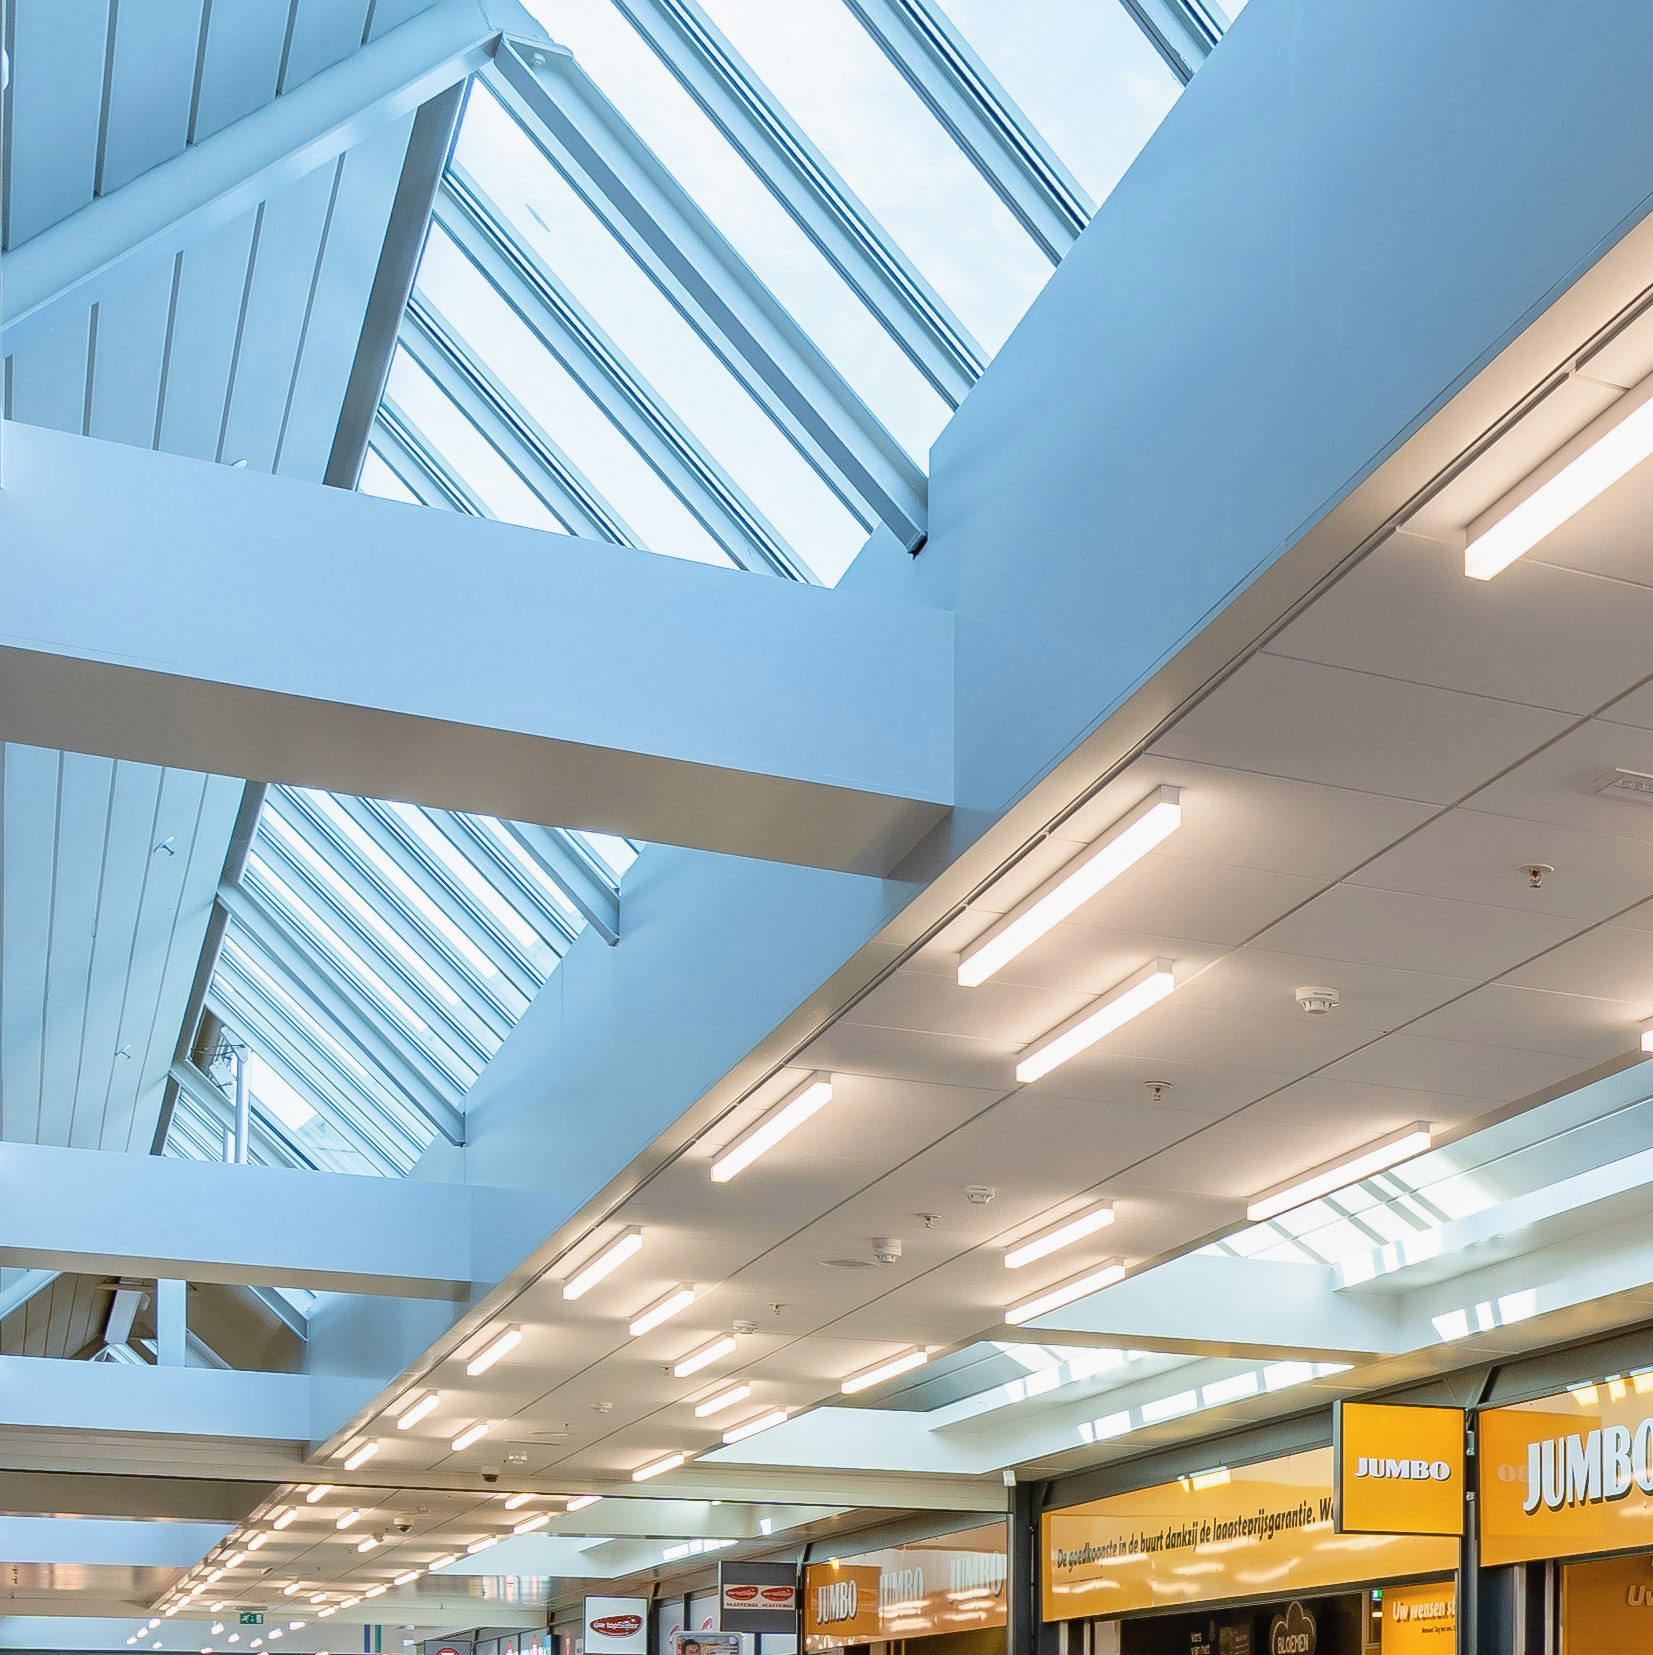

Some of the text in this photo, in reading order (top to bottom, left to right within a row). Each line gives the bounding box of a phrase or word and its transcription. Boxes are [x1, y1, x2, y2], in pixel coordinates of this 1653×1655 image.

[1355, 1457, 1451, 1481] JUMBO
[1057, 1548, 1067, 1568] De
[1119, 1536, 1127, 1556] in
[1128, 1533, 1138, 1555] de
[1140, 1529, 1163, 1553] buurt
[1165, 1525, 1198, 1553] dankzij
[1200, 1519, 1211, 1544] de
[1213, 1508, 1316, 1543] laagsteprijsgarantie.
[816, 1580, 858, 1624] JUMBO
[1392, 1600, 1446, 1622] Uw wensen
[1278, 1633, 1308, 1654] BLOEMEN
